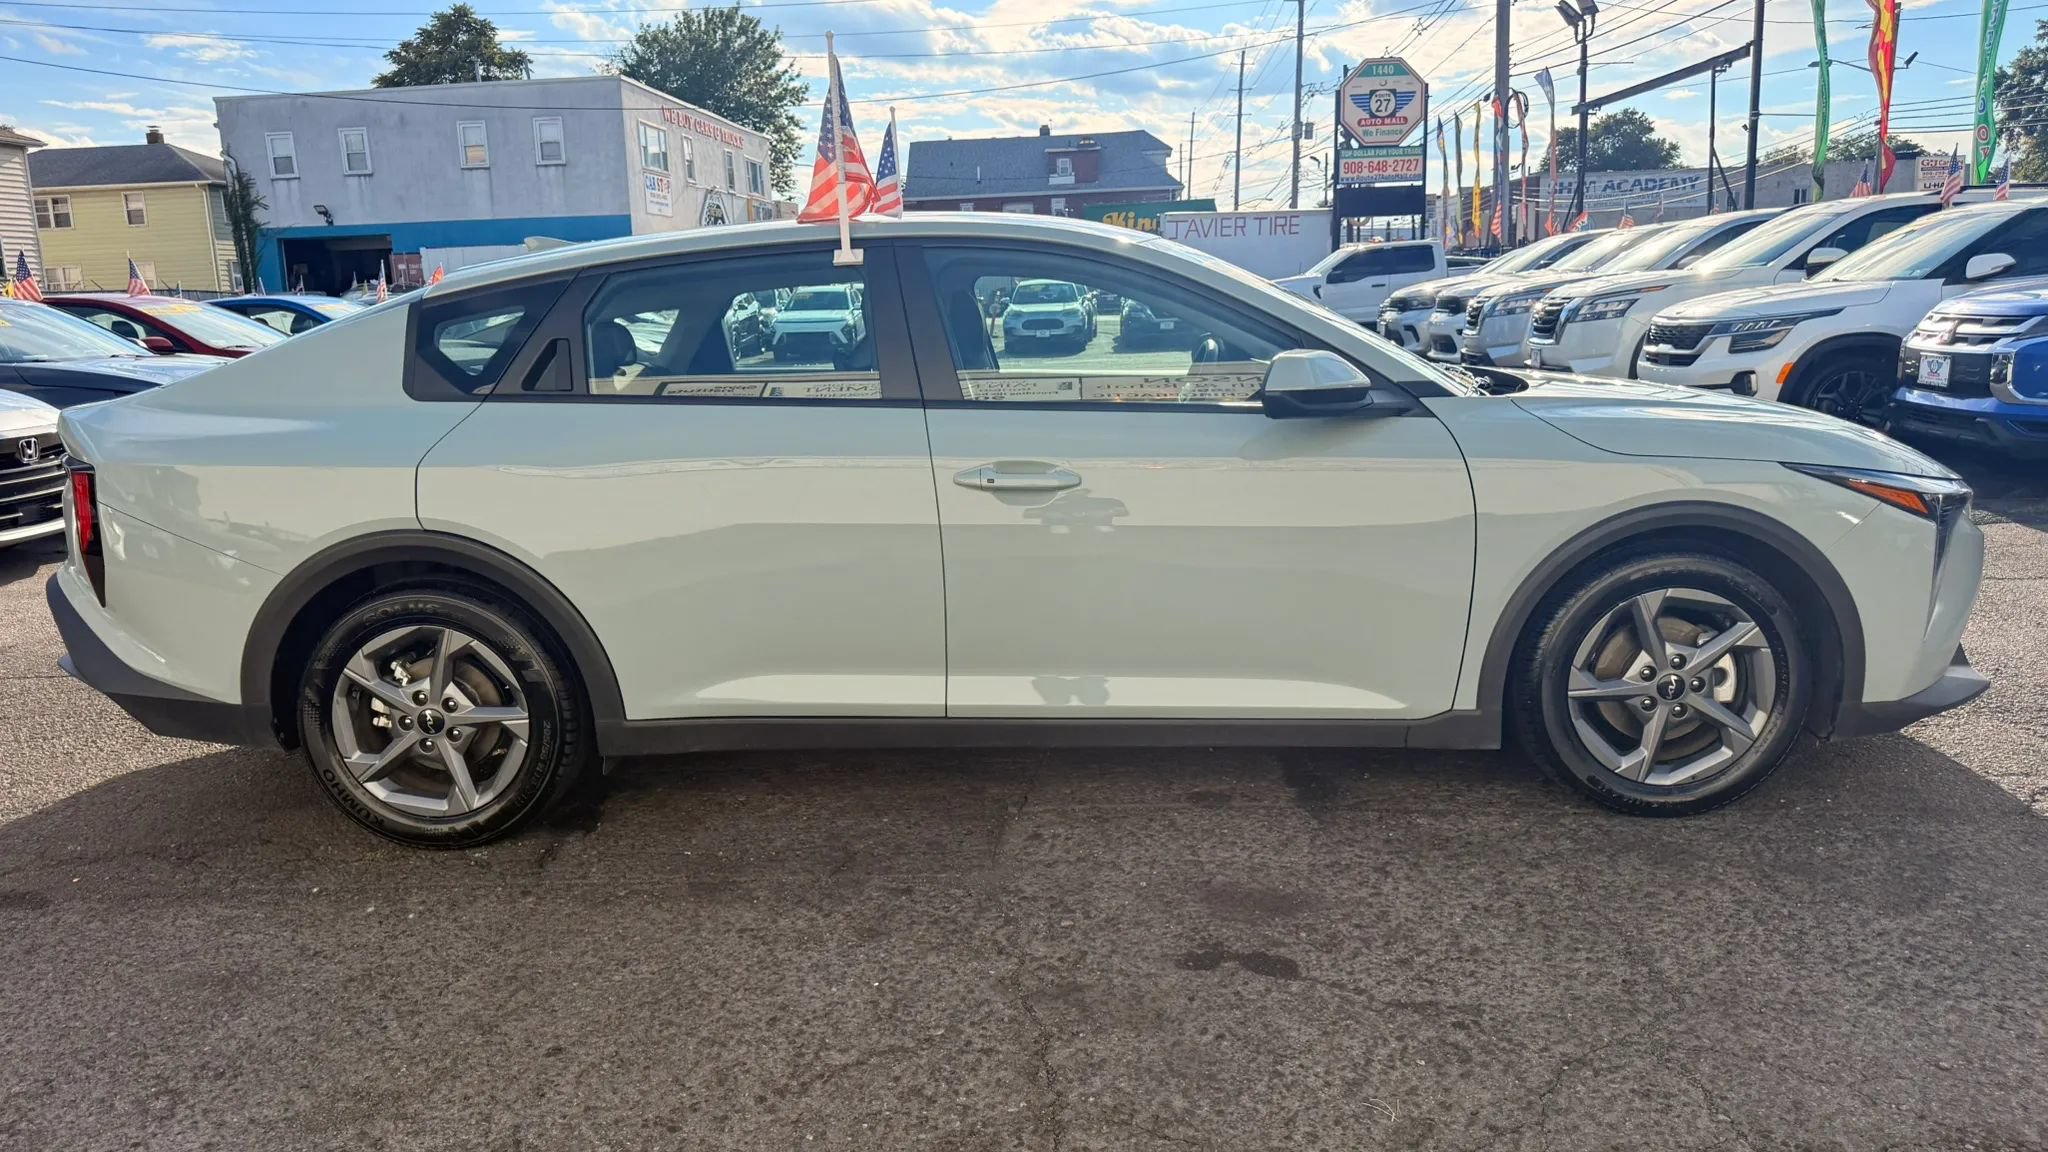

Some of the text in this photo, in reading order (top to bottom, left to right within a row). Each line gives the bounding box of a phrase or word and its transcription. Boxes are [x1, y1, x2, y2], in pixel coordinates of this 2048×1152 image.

[1372, 65, 1394, 75] 1440
[1375, 98, 1391, 113] 27
[1360, 117, 1405, 126] AUTO MALL
[1361, 128, 1404, 137] We Finance
[1343, 159, 1420, 174] 908-648-2727
[1601, 175, 1700, 193] ACADEMY
[1167, 215, 1301, 240] JAVIER TIRE
[322, 768, 385, 827] KUMHO
